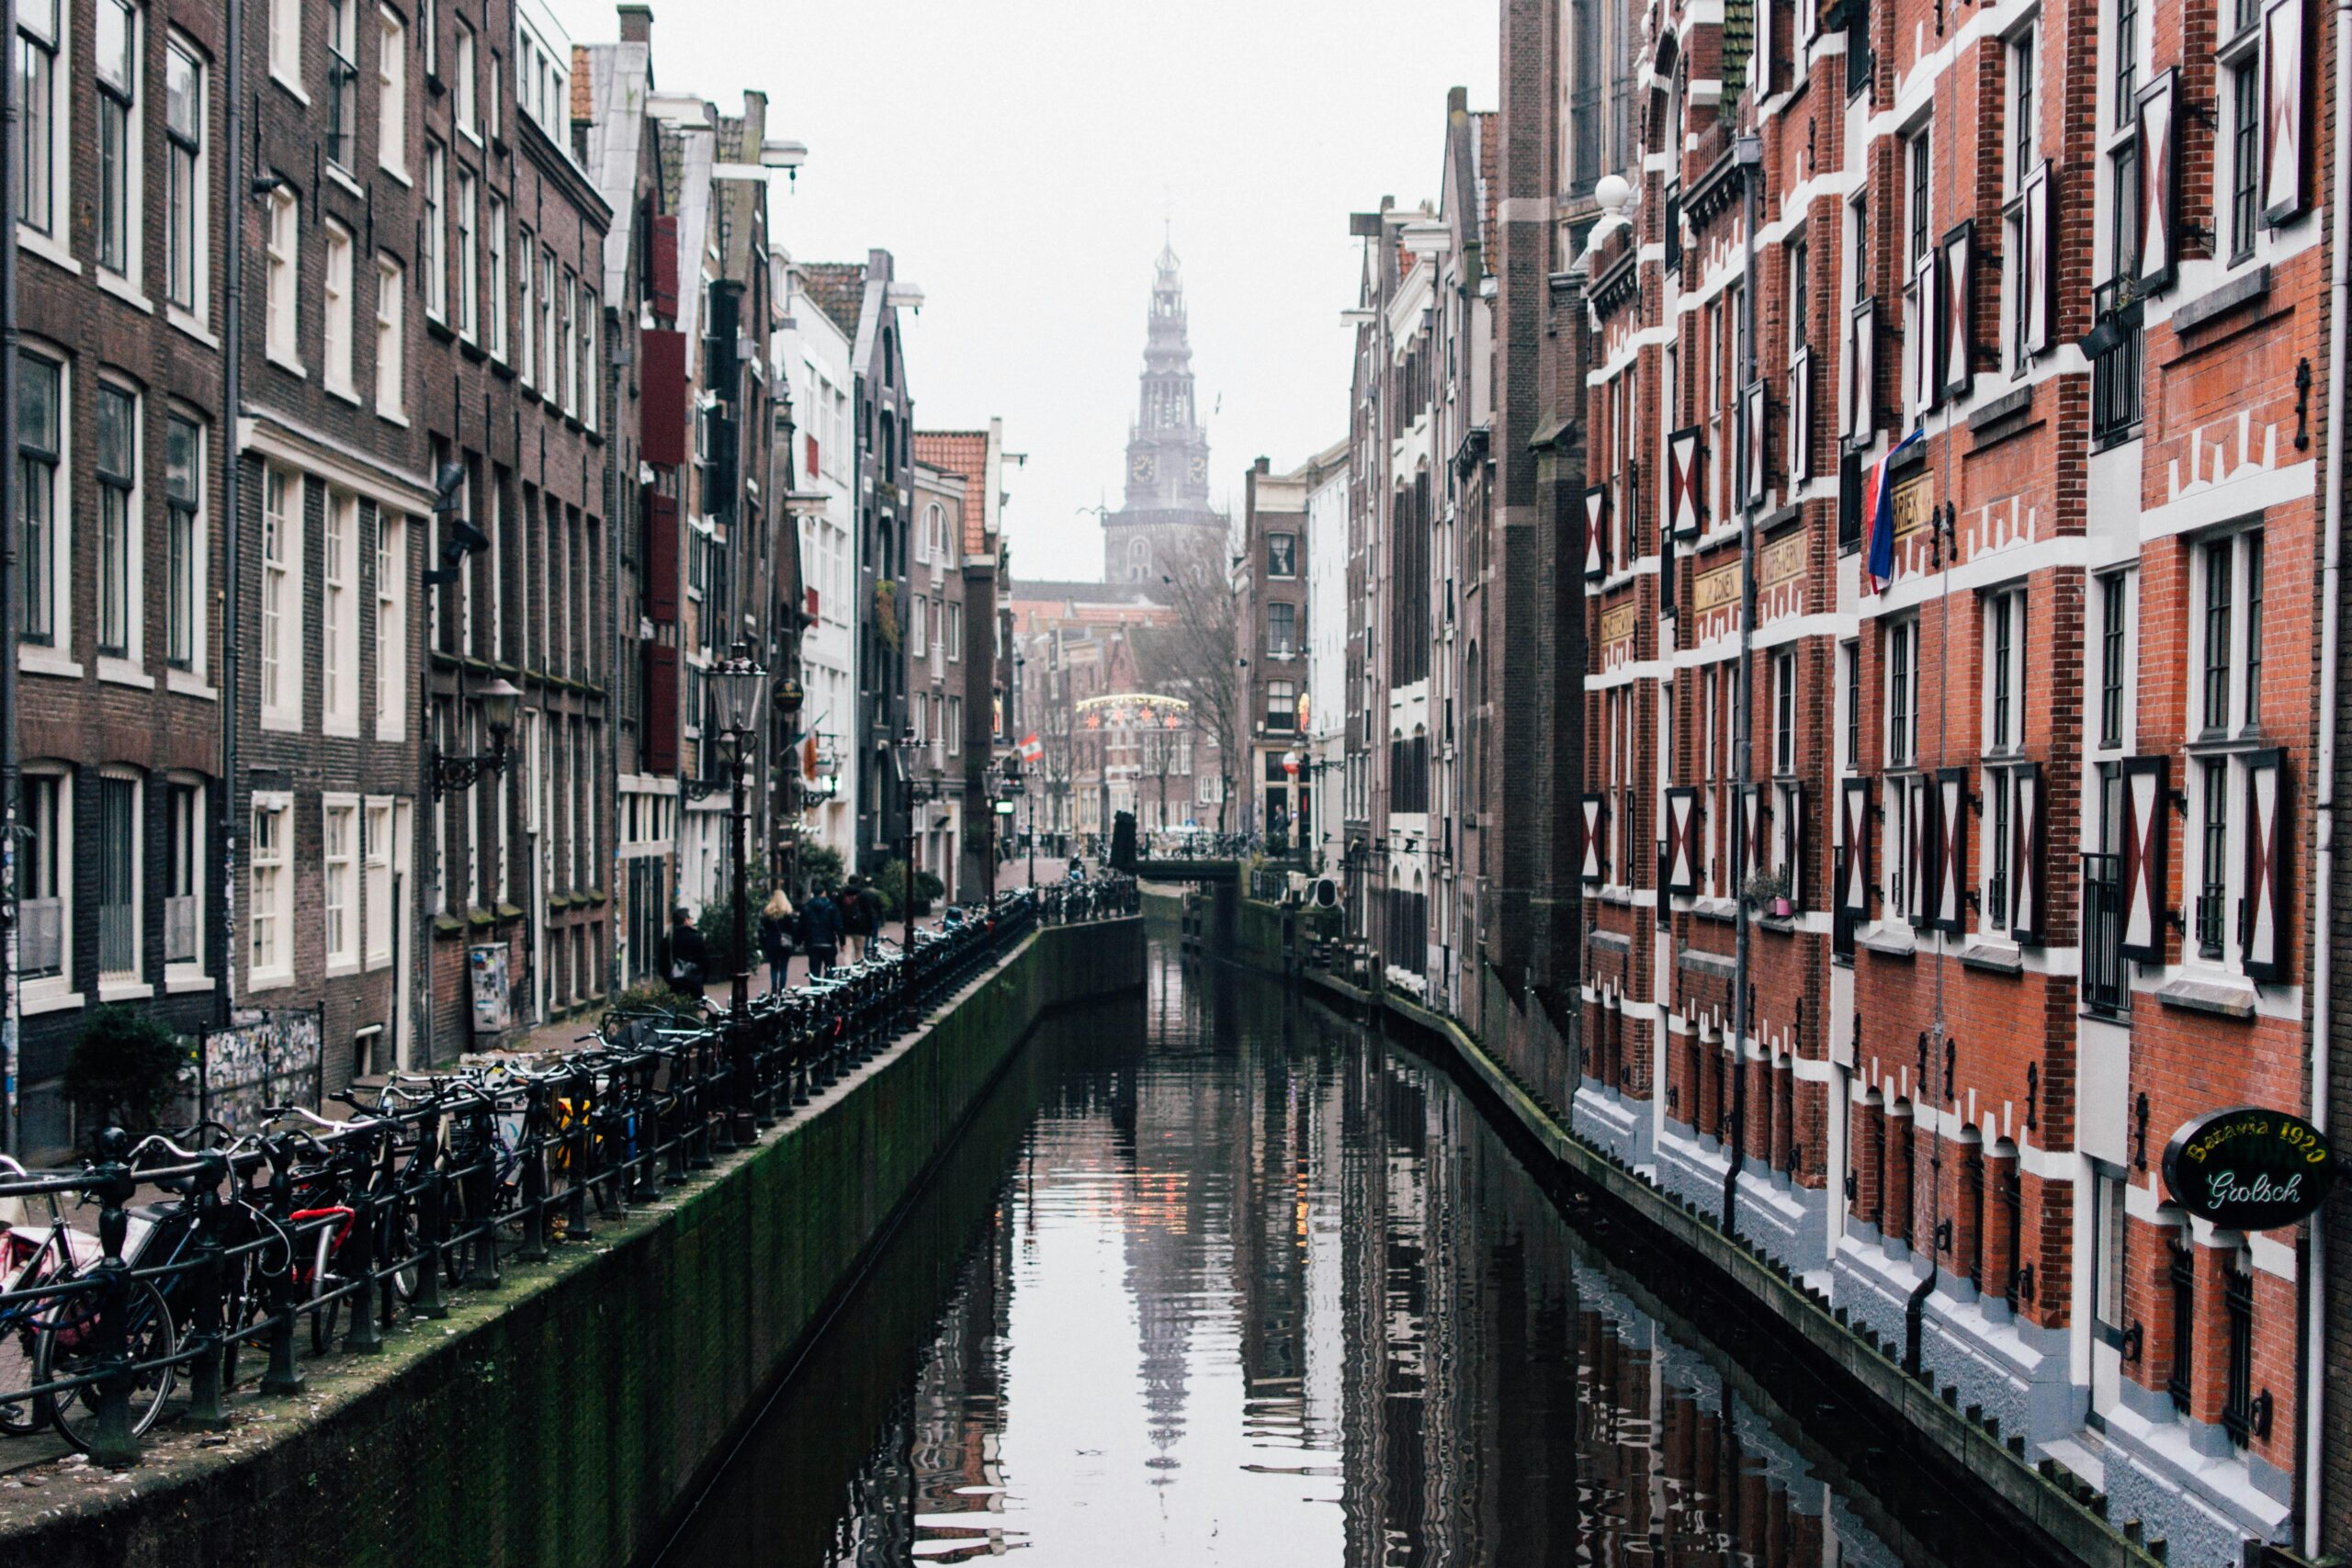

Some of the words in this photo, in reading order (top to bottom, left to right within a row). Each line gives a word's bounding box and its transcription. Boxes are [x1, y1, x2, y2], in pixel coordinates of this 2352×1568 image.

[2186, 1115, 2269, 1164] Batavia
[2279, 1122, 2327, 1163] 1920
[2208, 1169, 2302, 1210] Grolsch
